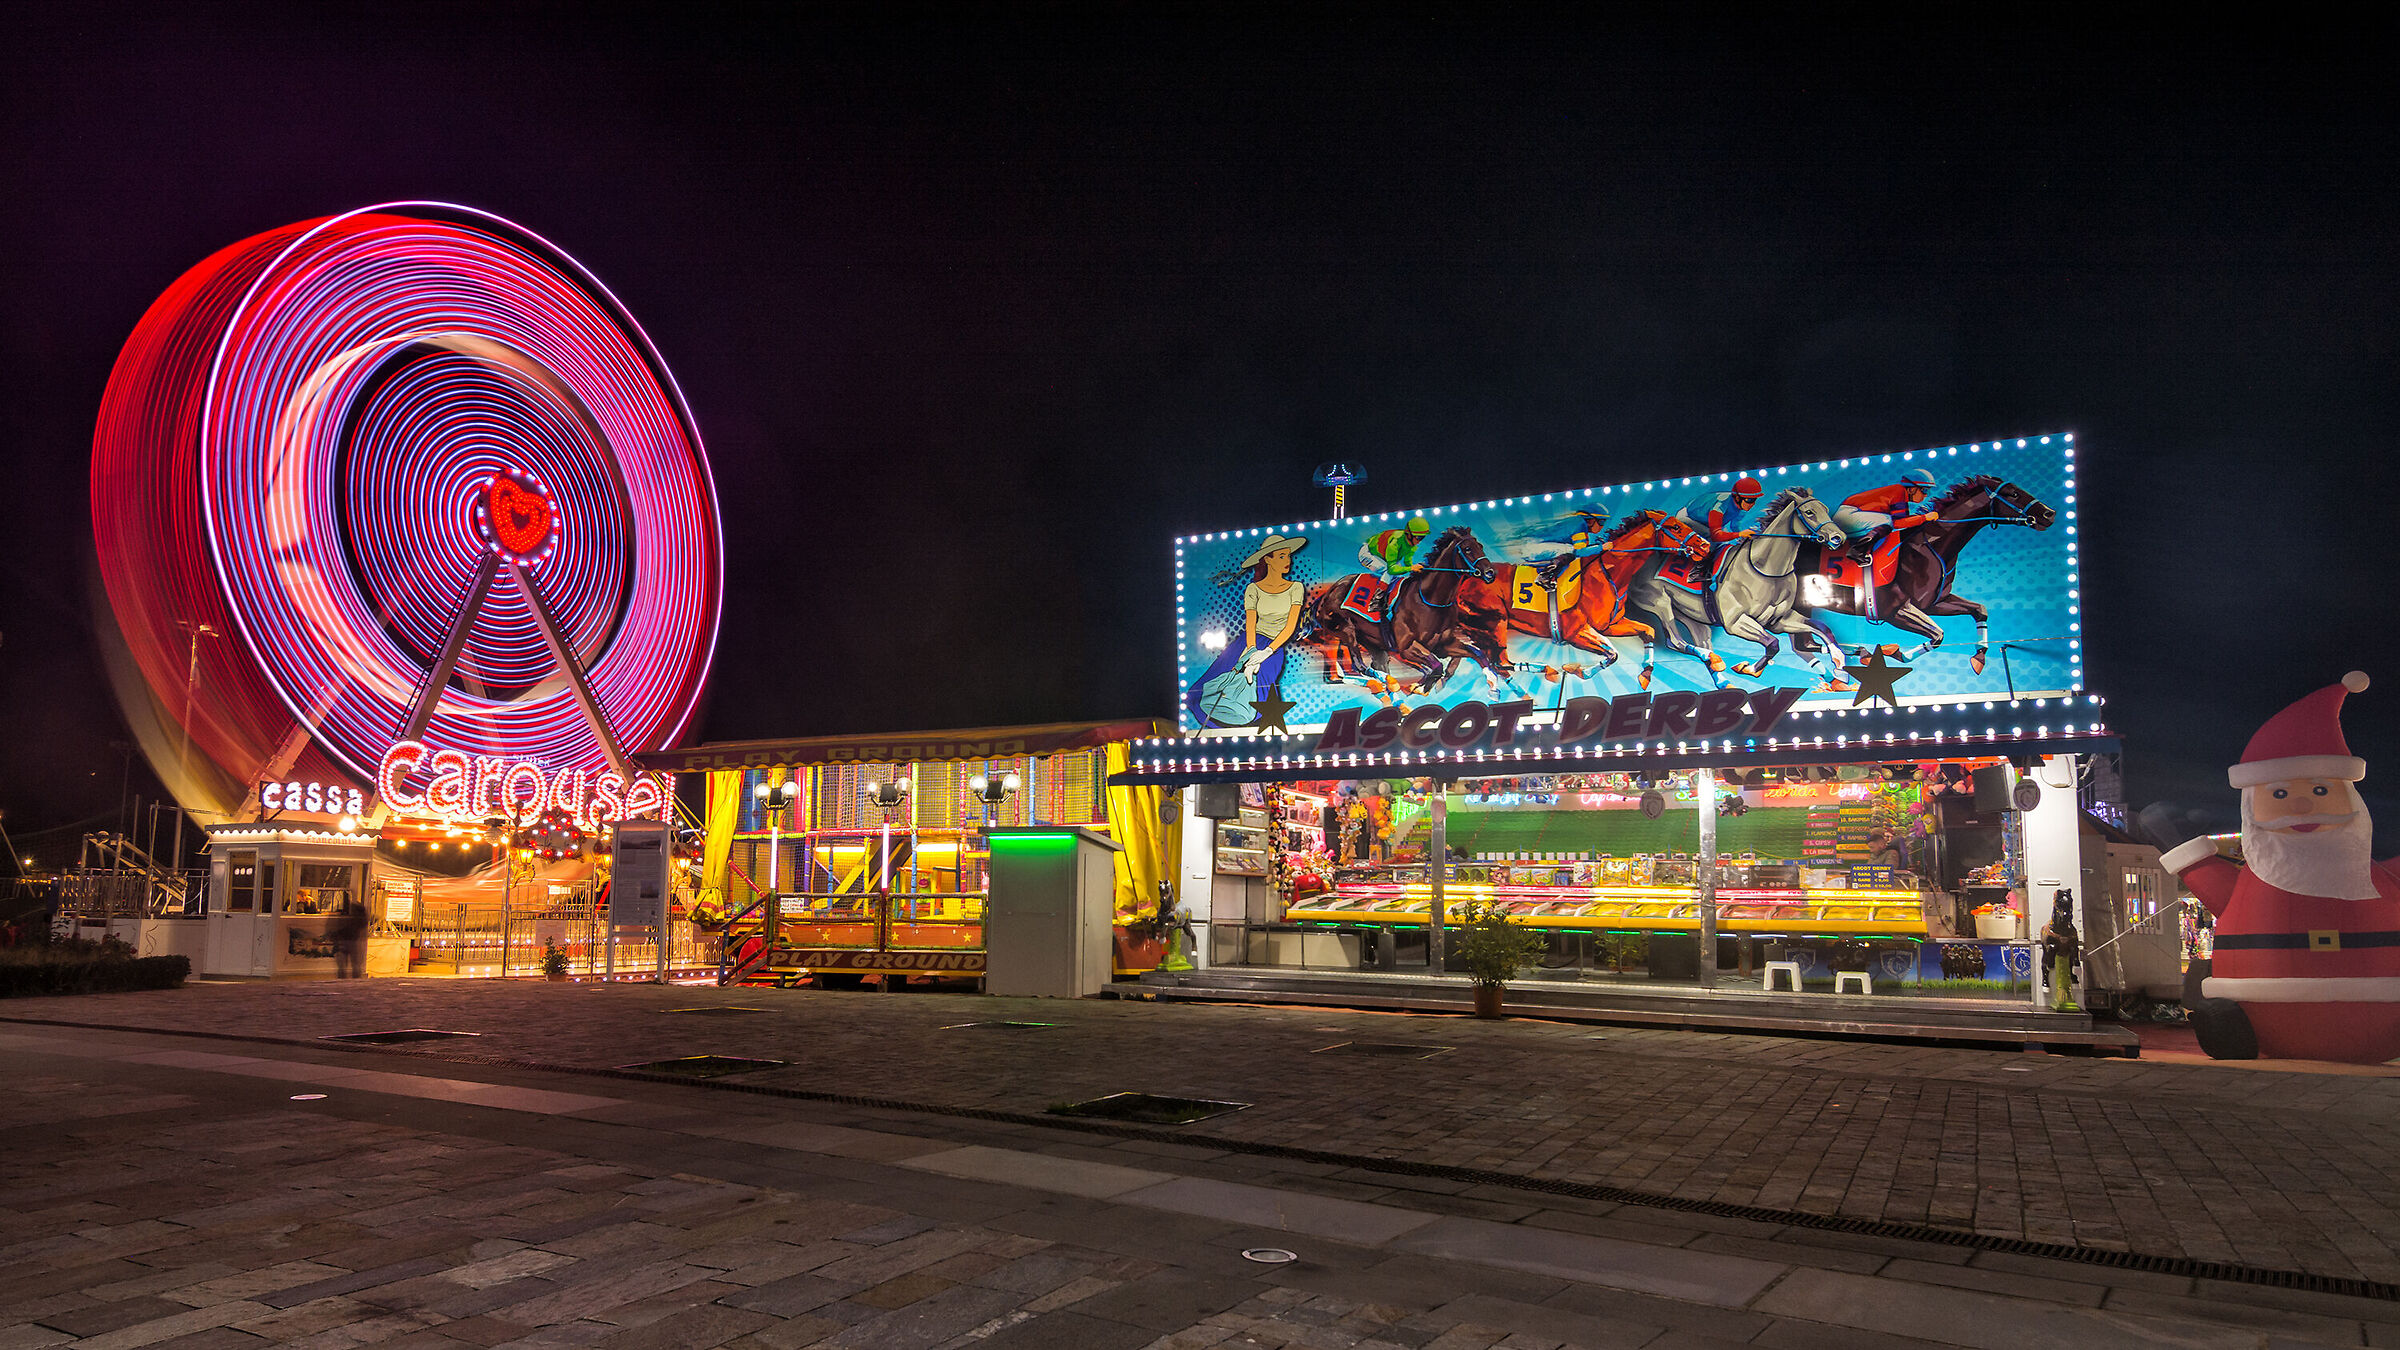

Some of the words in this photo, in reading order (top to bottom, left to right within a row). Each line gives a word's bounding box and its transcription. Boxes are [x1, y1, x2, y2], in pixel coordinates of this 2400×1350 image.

[1669, 556, 1689, 575] 2
[1827, 557, 1843, 580] 5
[1352, 585, 1371, 605] 2
[1517, 582, 1534, 604] 5
[1316, 700, 1535, 753] ASCOT
[1554, 685, 1809, 745] DERBY
[685, 750, 802, 769] PLAY
[826, 739, 1025, 761] GROUND
[378, 739, 676, 828] Carousel
[262, 781, 363, 815] cassa
[769, 952, 843, 967] PLAY
[851, 952, 985, 970] GROUND
